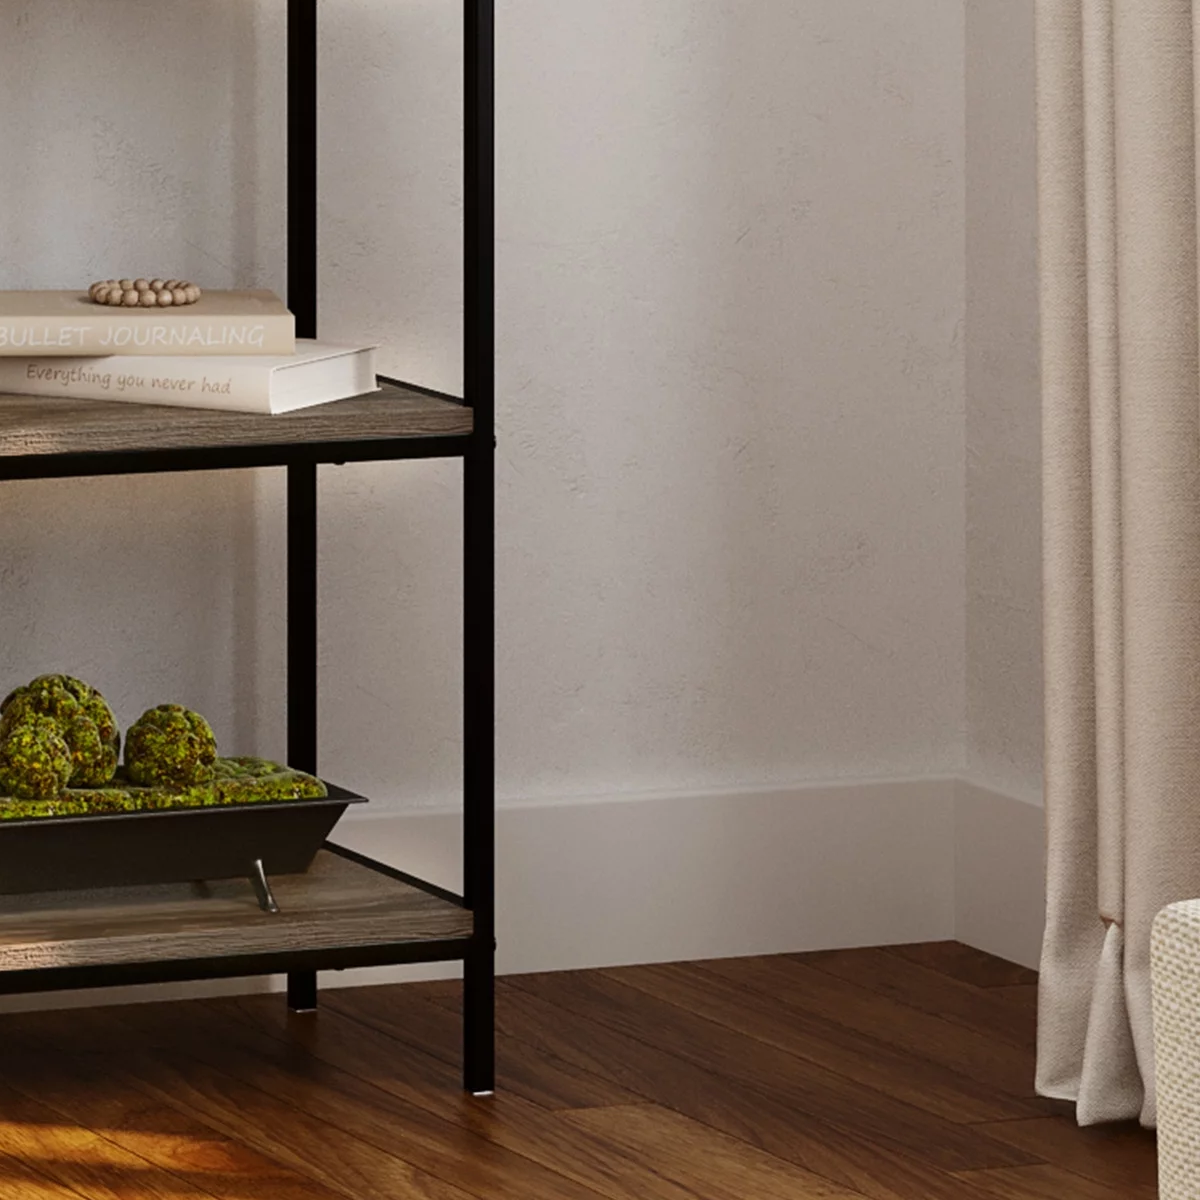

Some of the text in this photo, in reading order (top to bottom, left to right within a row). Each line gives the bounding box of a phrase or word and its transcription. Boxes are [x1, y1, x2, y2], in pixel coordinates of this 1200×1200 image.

[99, 325, 265, 347] JOURNALING
[26, 364, 232, 394] Everything you never had
